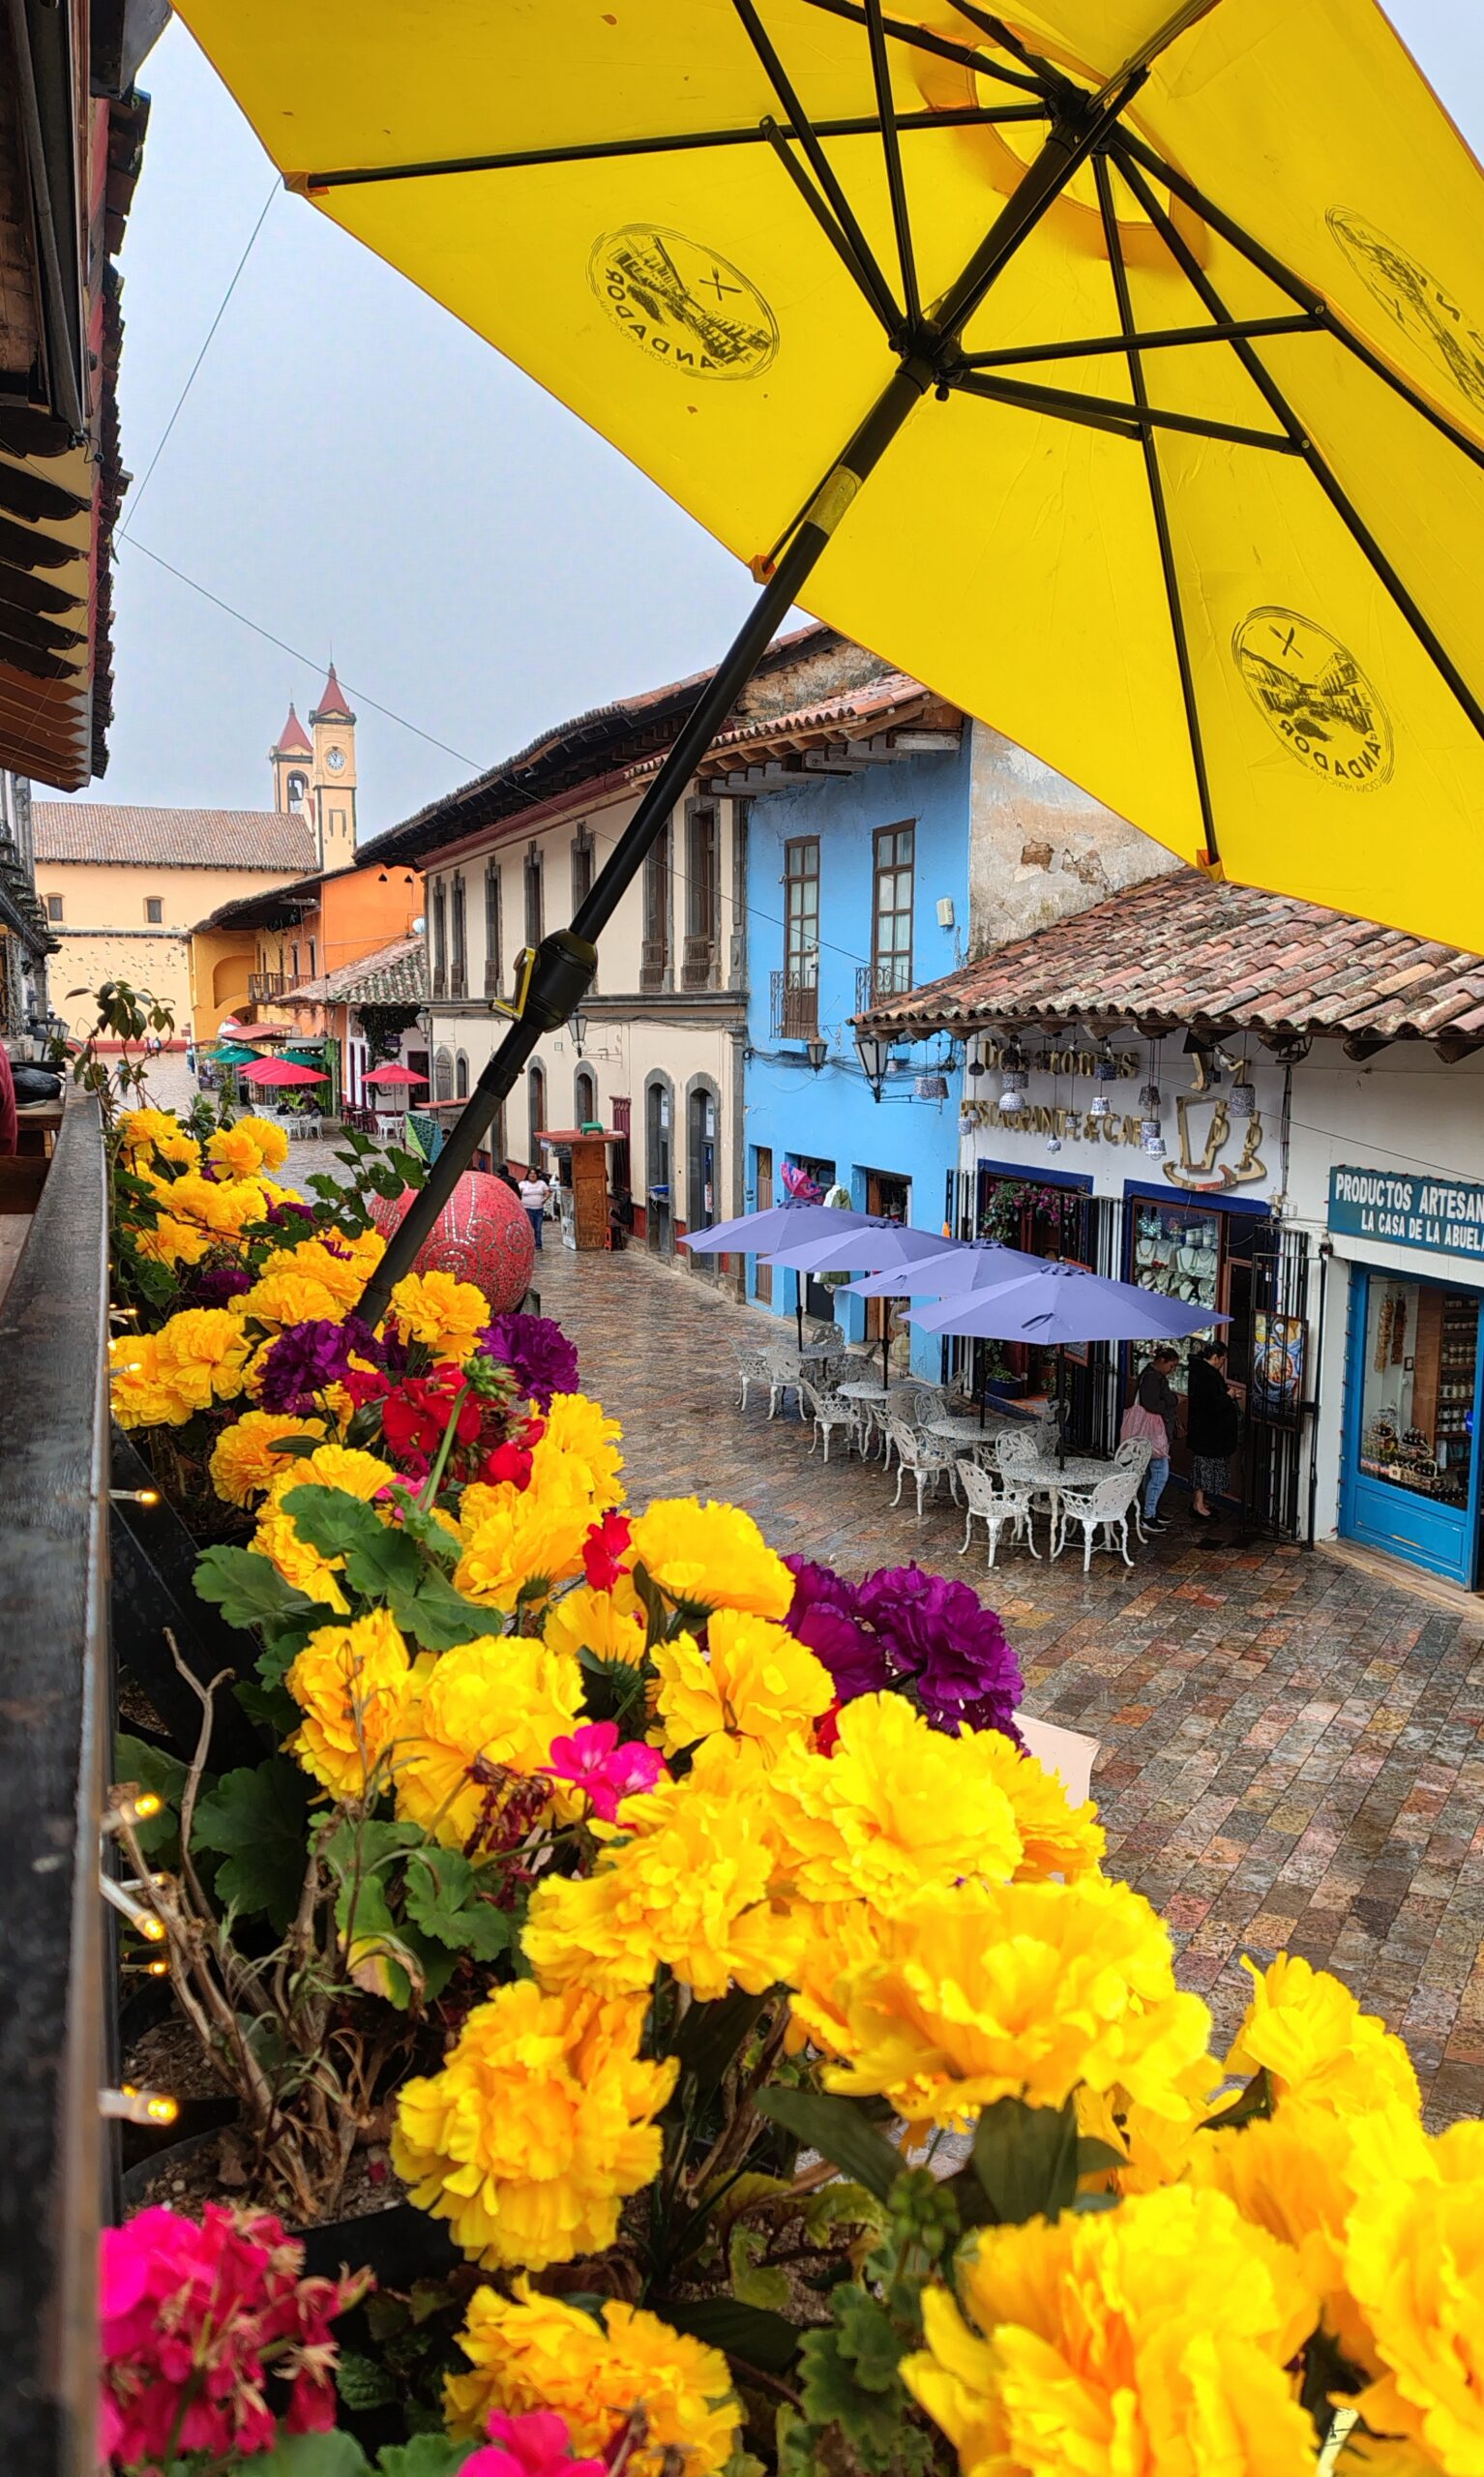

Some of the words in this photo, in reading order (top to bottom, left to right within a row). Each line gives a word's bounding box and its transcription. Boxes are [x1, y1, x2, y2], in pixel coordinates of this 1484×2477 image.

[1335, 1173, 1413, 1211] PRODUCTOS
[1361, 1209, 1374, 1232] LA
[1378, 1211, 1406, 1238] CASA
[1409, 1217, 1423, 1240] DE
[1425, 1219, 1440, 1244] LA
